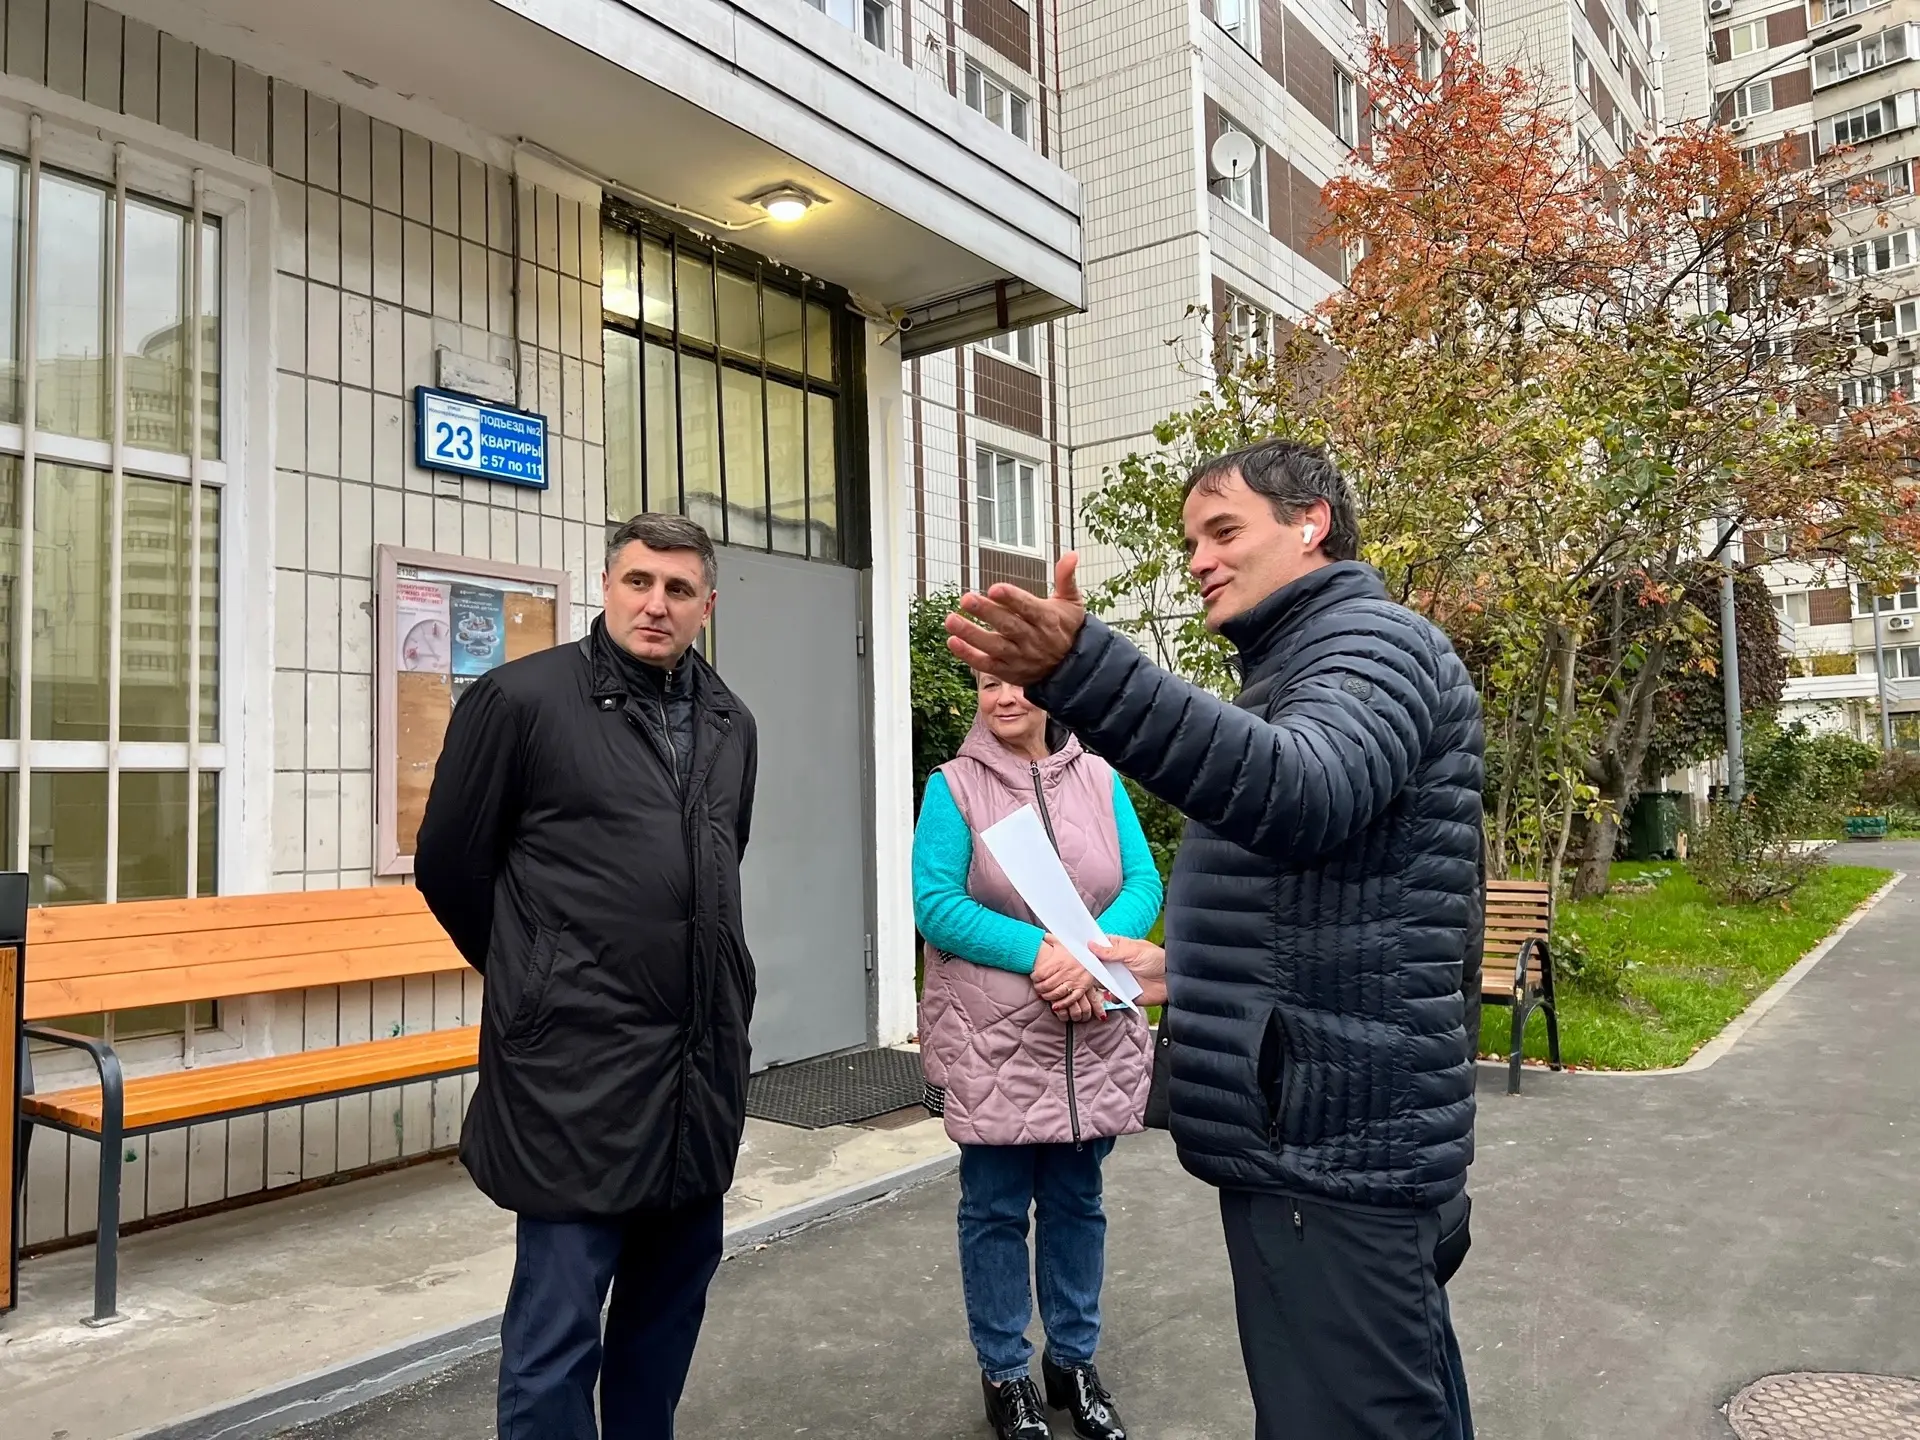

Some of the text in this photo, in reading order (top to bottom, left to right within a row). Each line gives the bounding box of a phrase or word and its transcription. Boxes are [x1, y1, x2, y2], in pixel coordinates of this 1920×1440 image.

[480, 414, 541, 437] ПОДЪЕЗД №2
[436, 421, 474, 461] 23
[481, 433, 541, 458] КВАРТИРЫ
[481, 454, 542, 477] с 57 по 111
